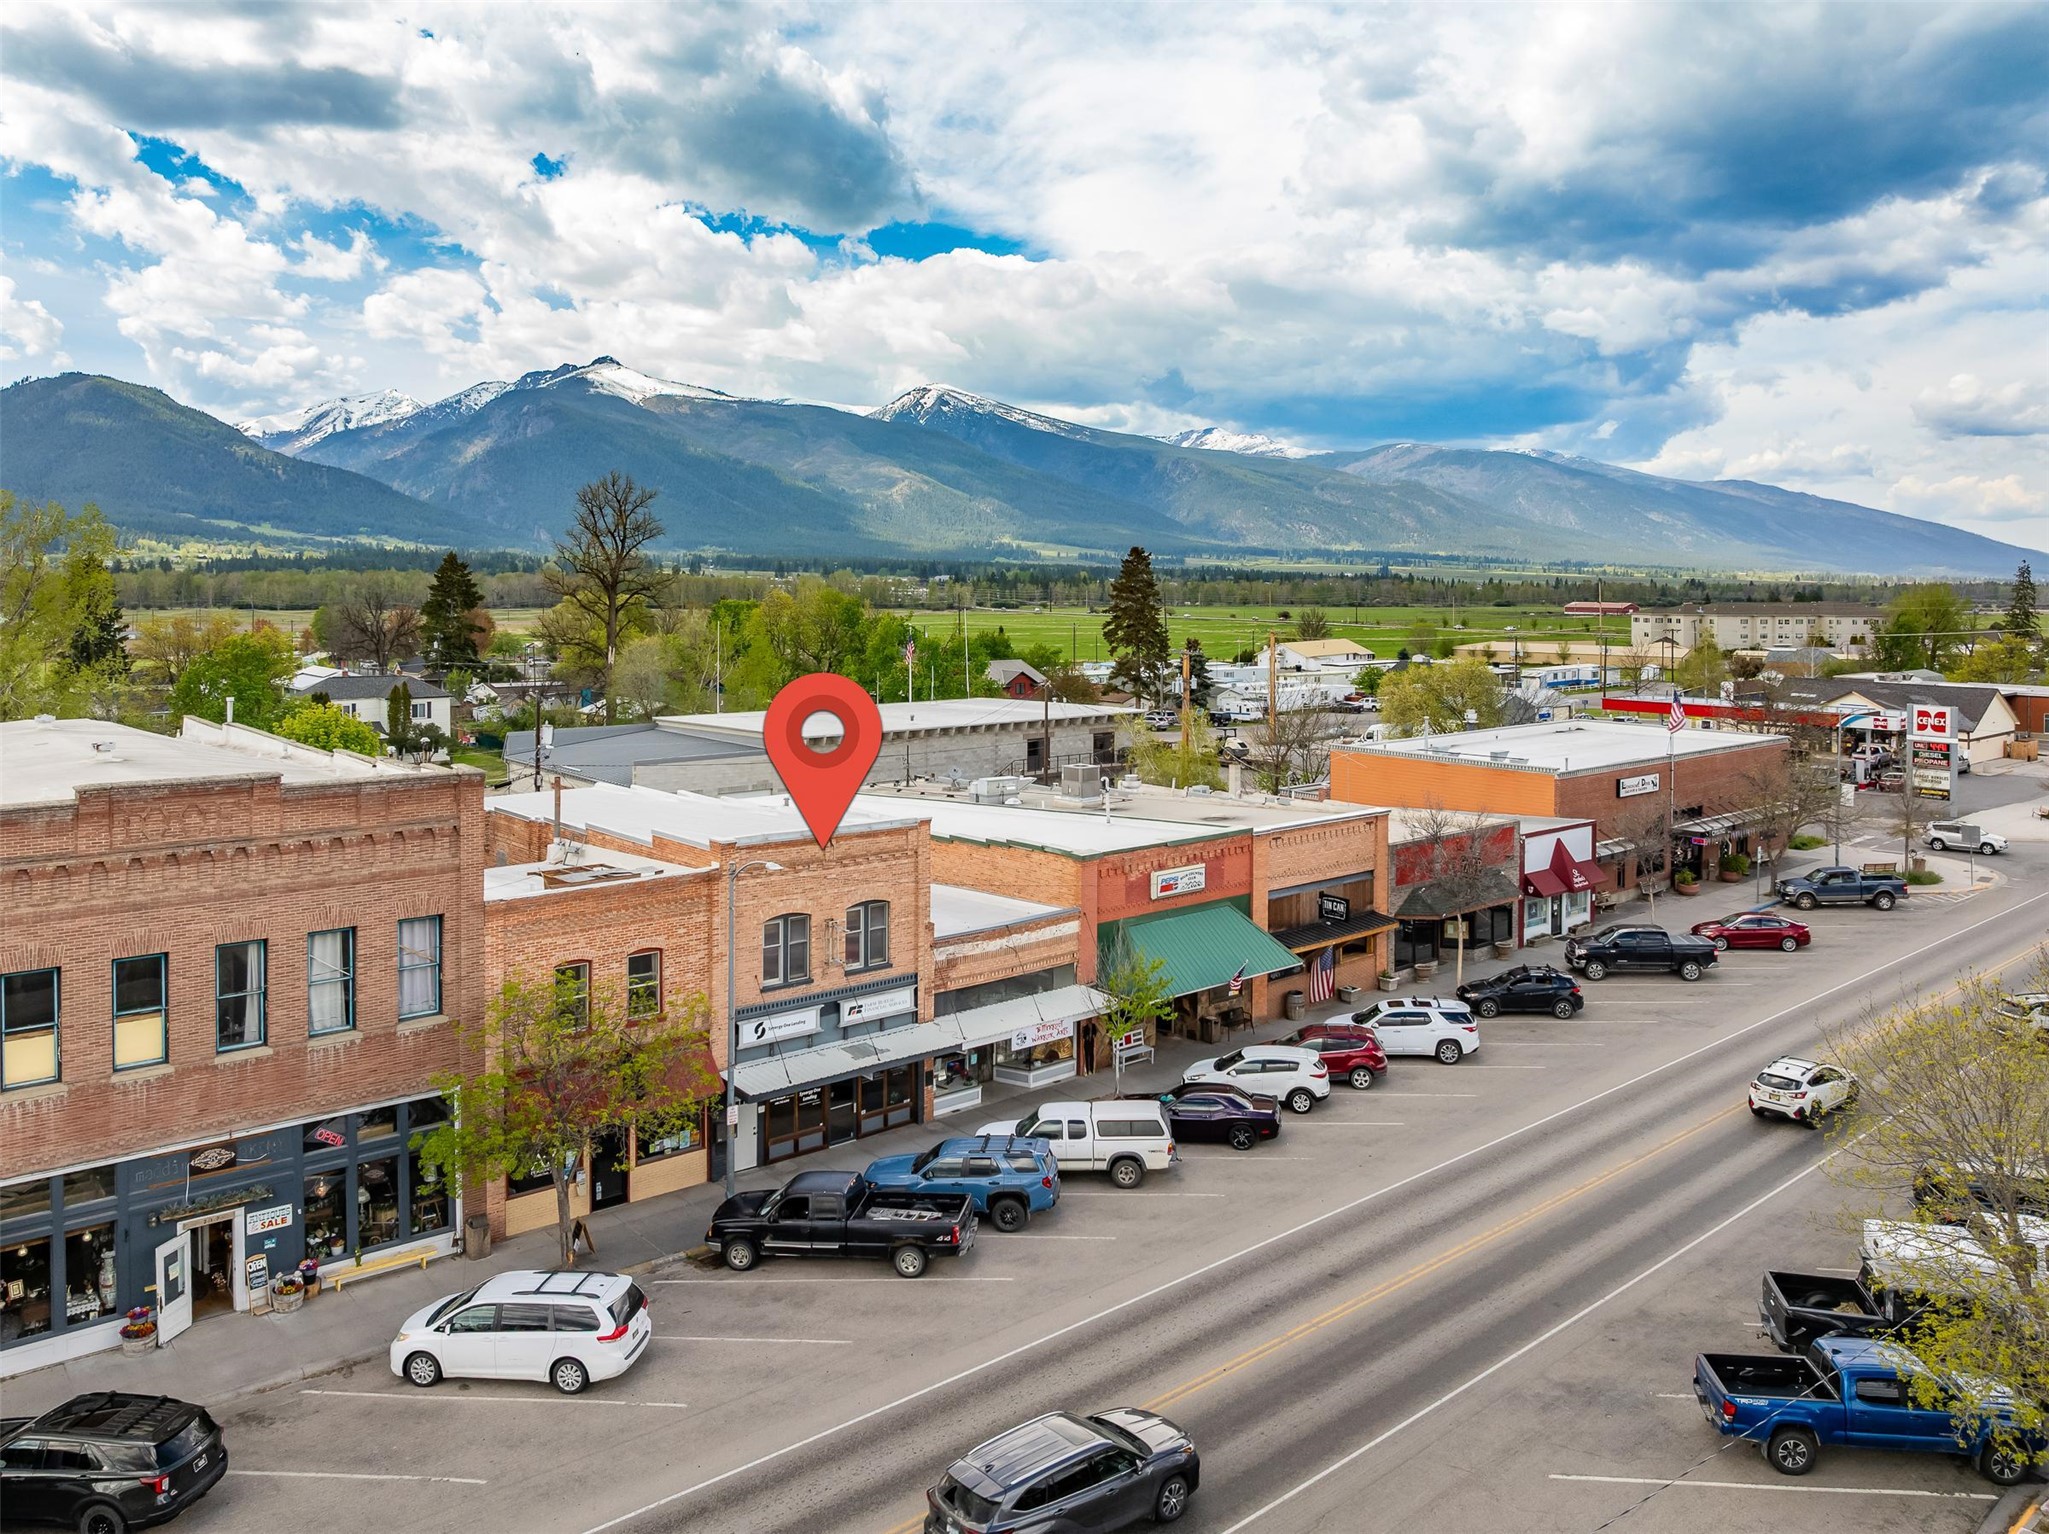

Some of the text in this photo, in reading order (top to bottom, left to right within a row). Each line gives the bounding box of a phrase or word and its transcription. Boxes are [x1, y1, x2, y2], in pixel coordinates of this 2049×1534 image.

[1917, 716, 1946, 726] CENEX
[1918, 751, 1944, 759] DIESEL
[1913, 758, 1949, 766] PROPANE
[1160, 876, 1179, 885] PEPSI
[1323, 900, 1345, 912] TIN CAN
[791, 1019, 806, 1027] Lending
[317, 1128, 343, 1146] OPEN
[248, 1206, 291, 1225] ANTIQUES
[260, 1216, 287, 1230] SALE
[248, 1258, 267, 1273] OPEN
